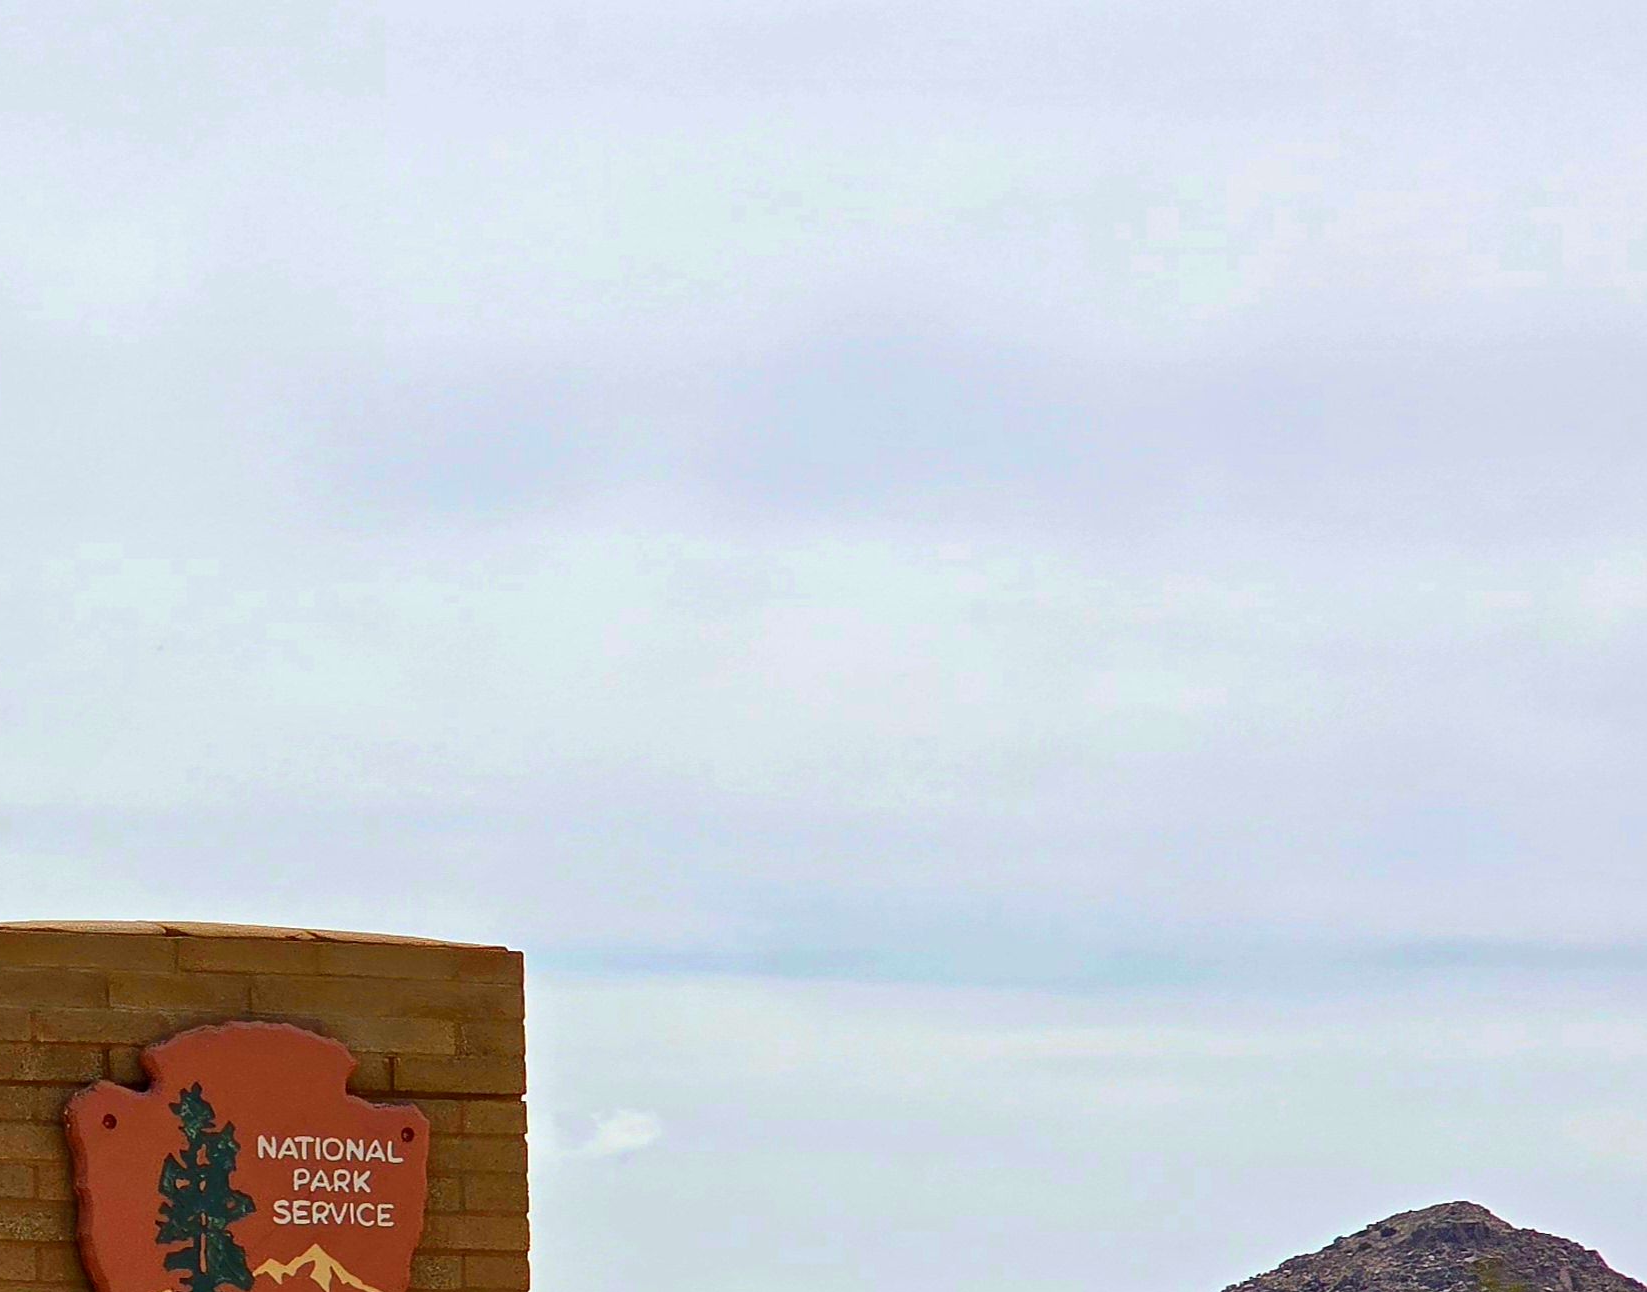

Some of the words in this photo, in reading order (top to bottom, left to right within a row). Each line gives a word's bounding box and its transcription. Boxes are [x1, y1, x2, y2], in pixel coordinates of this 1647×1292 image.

[257, 1134, 404, 1164] NATIONAL
[293, 1168, 371, 1193] PARK
[272, 1199, 395, 1227] SERVICE
